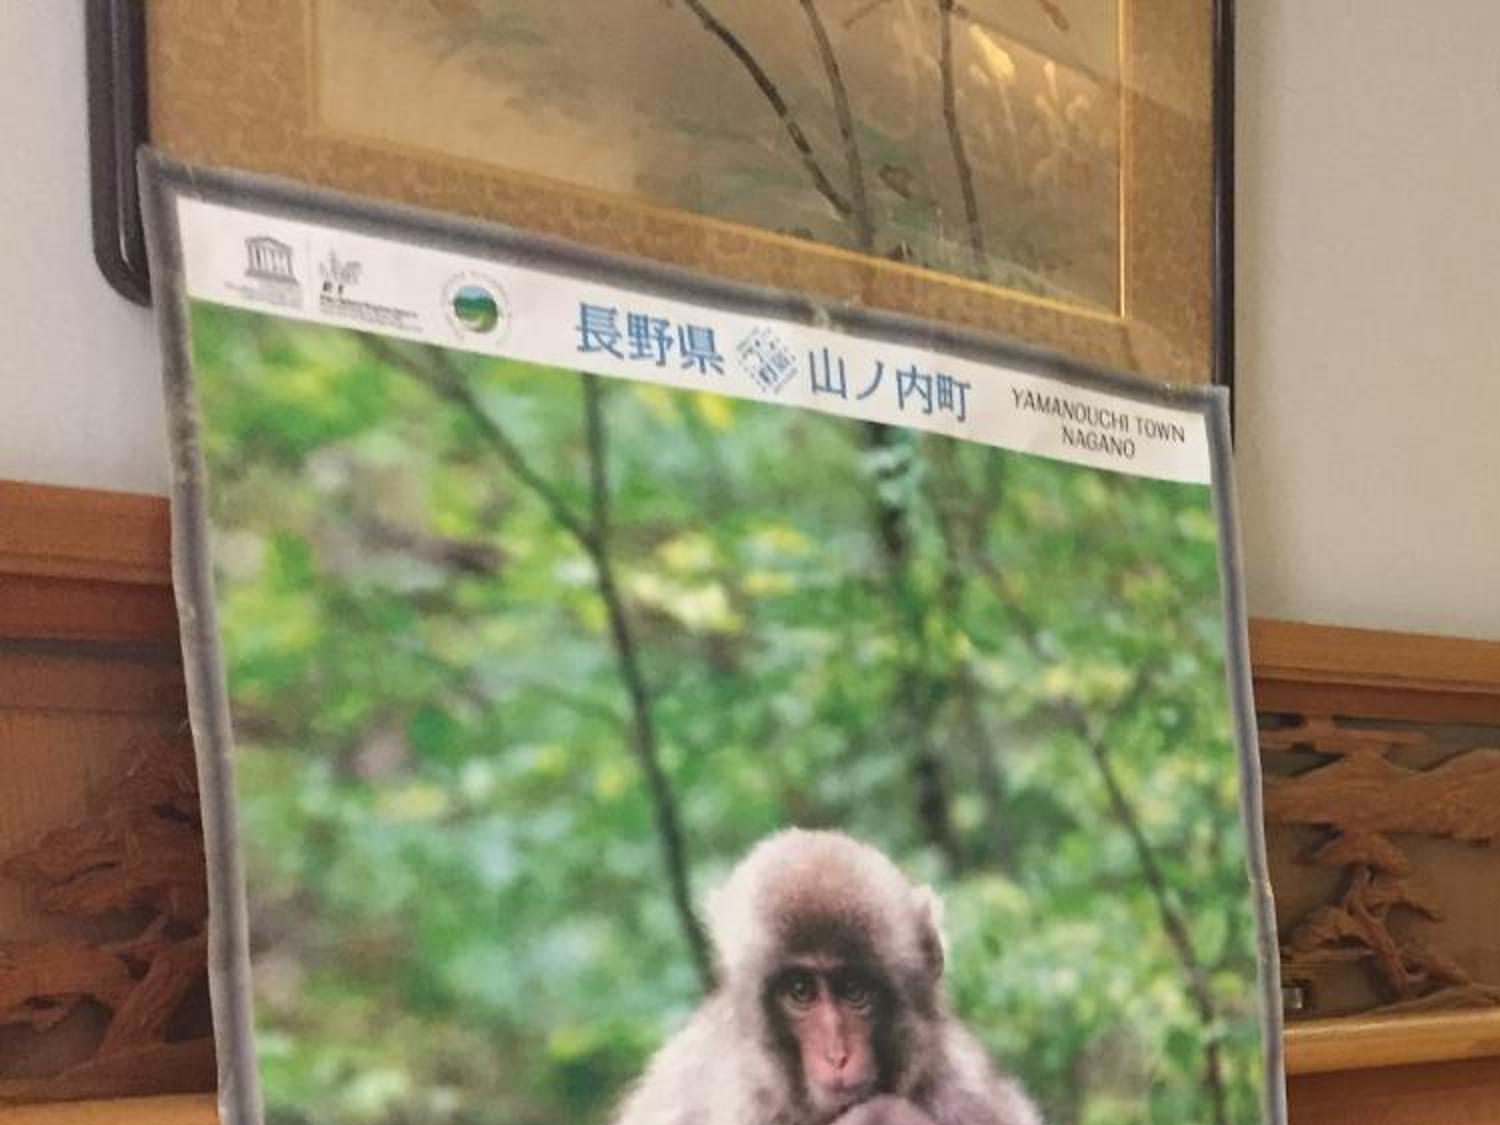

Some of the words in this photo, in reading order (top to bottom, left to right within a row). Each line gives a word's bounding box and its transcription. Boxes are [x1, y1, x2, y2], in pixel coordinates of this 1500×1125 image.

[575, 301, 726, 376] 長野県
[809, 346, 972, 423] 山ノ内町
[1011, 386, 1130, 432] YAMANOUCHI
[1134, 416, 1186, 443] TOWN
[1061, 426, 1136, 460] NAGANO
